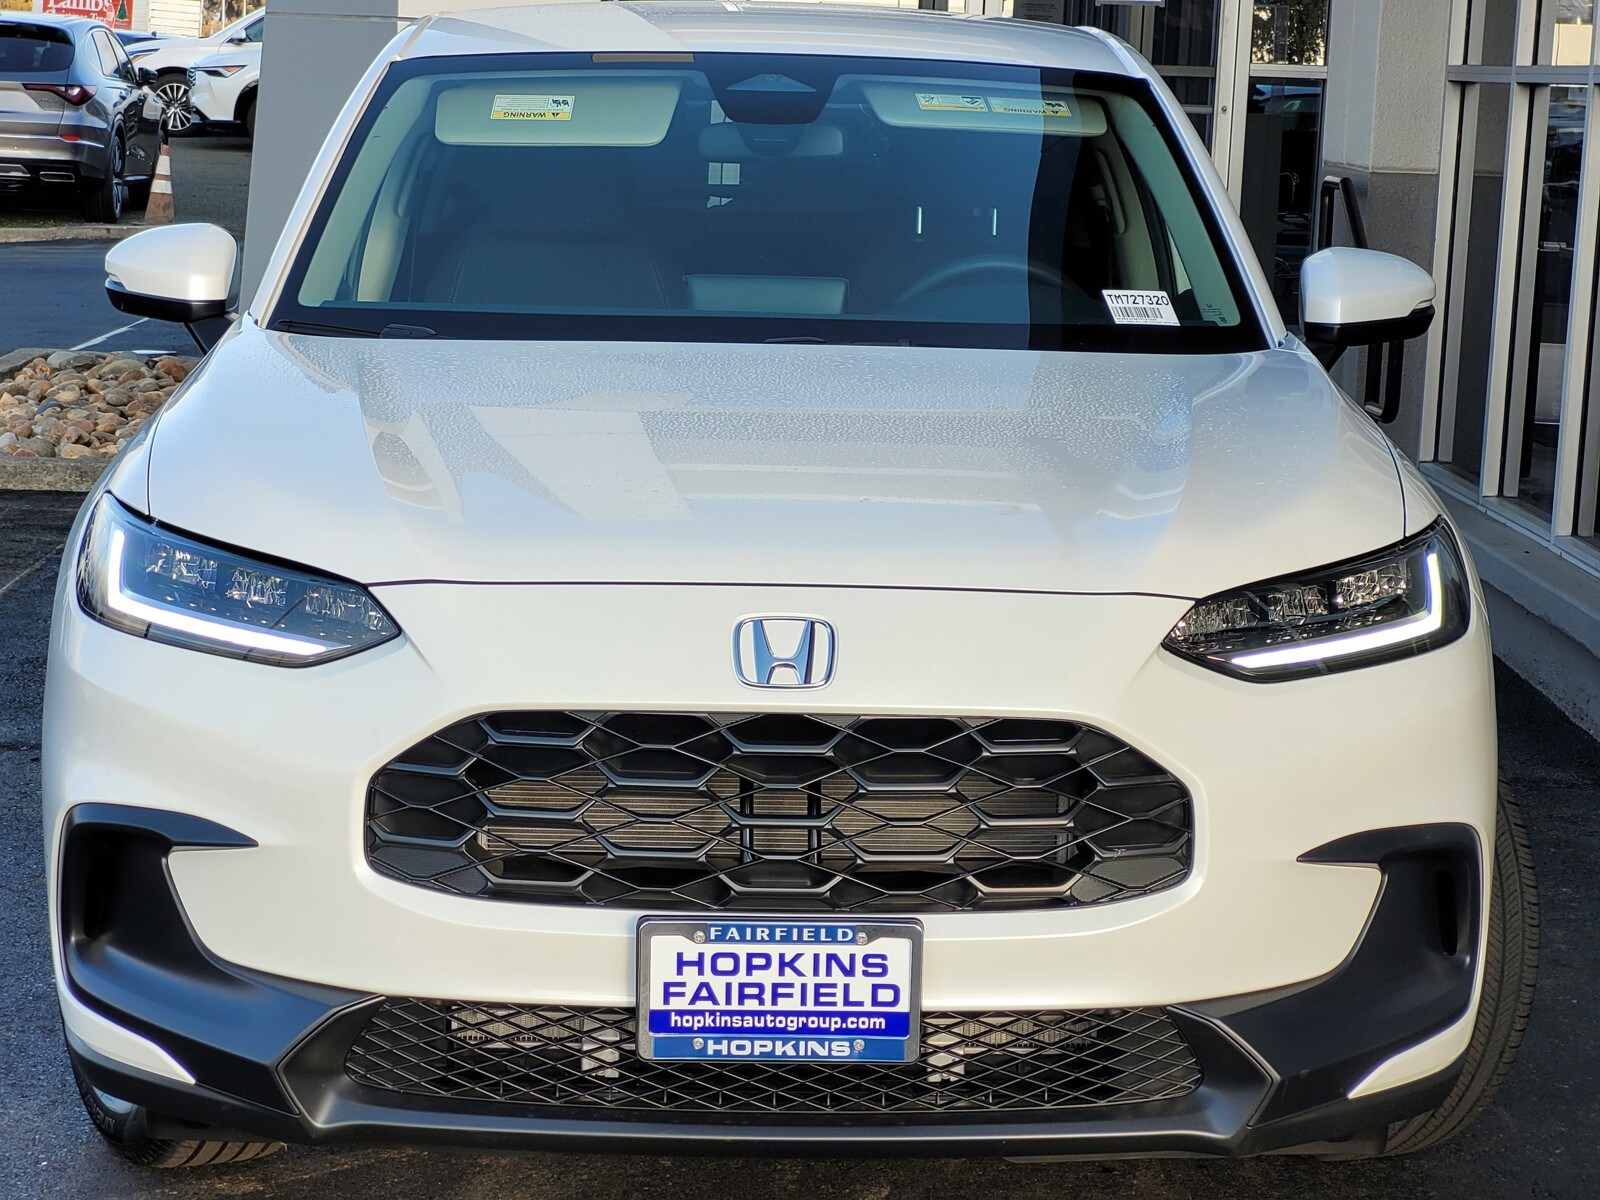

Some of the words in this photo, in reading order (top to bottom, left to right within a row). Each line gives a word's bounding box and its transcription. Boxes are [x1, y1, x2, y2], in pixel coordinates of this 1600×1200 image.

[1003, 107, 1047, 115] WARNING
[1106, 294, 1170, 306] TM727320
[709, 927, 854, 942] FAIRFIELD
[676, 952, 889, 978] HOPKINS
[663, 981, 901, 1008] FAIRFIELD
[670, 1012, 886, 1031] hopkinsautogroup.com
[707, 1040, 851, 1057] HOPKINS
